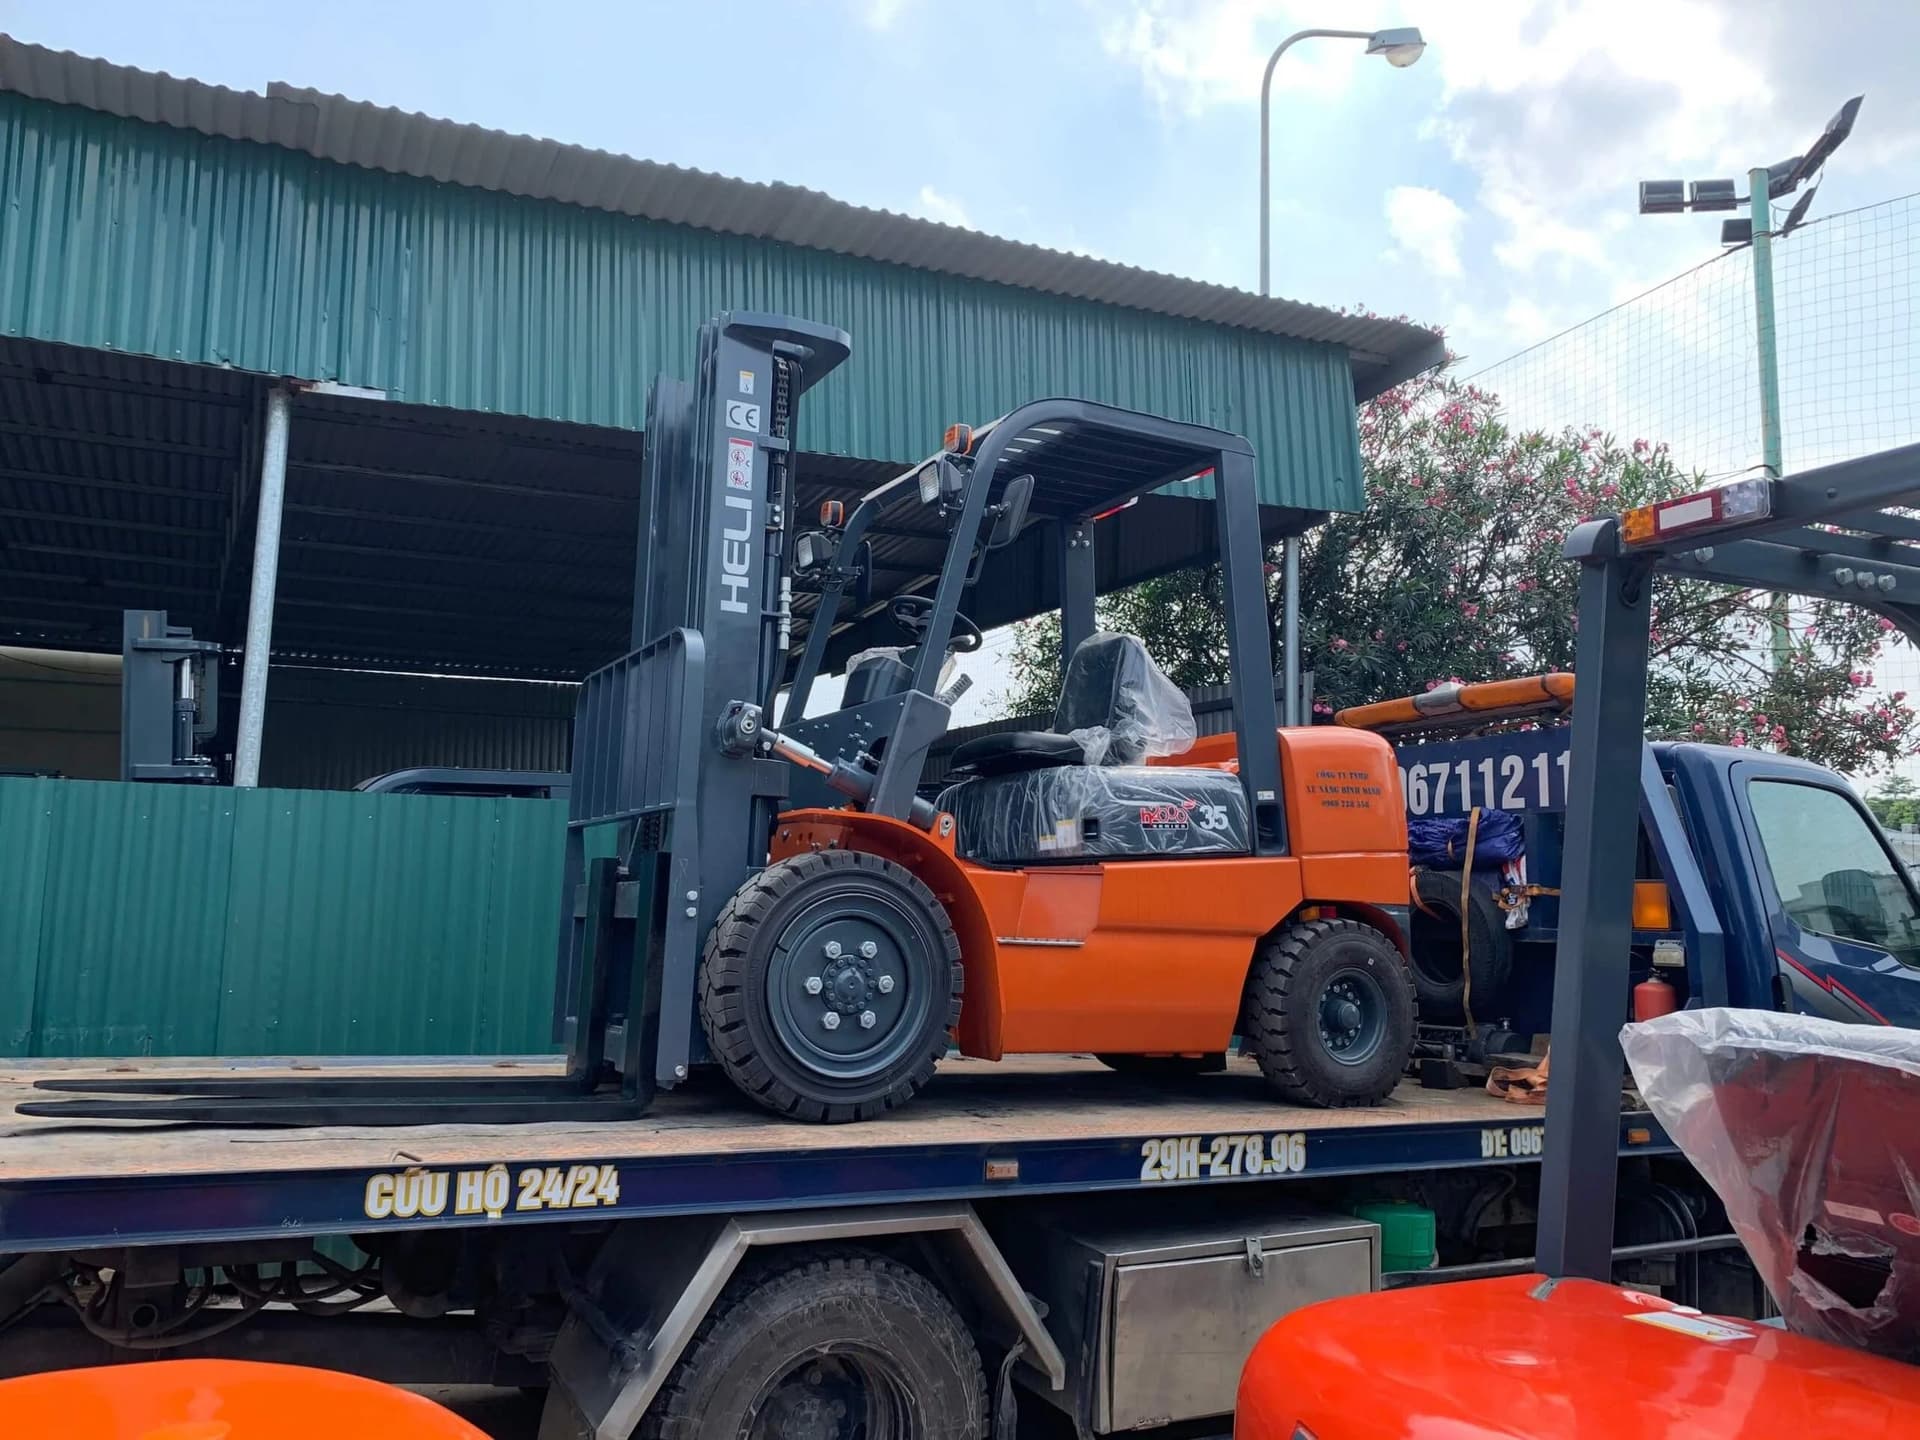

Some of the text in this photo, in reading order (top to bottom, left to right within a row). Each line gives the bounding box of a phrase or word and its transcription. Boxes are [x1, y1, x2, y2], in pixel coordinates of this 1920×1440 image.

[729, 405, 757, 428] CE
[720, 496, 752, 614] HELI
[1199, 804, 1229, 830] 35
[1140, 1132, 1307, 1181] 29H-278.96
[455, 1163, 511, 1218] HỘ
[516, 1164, 620, 1211] 24/24
